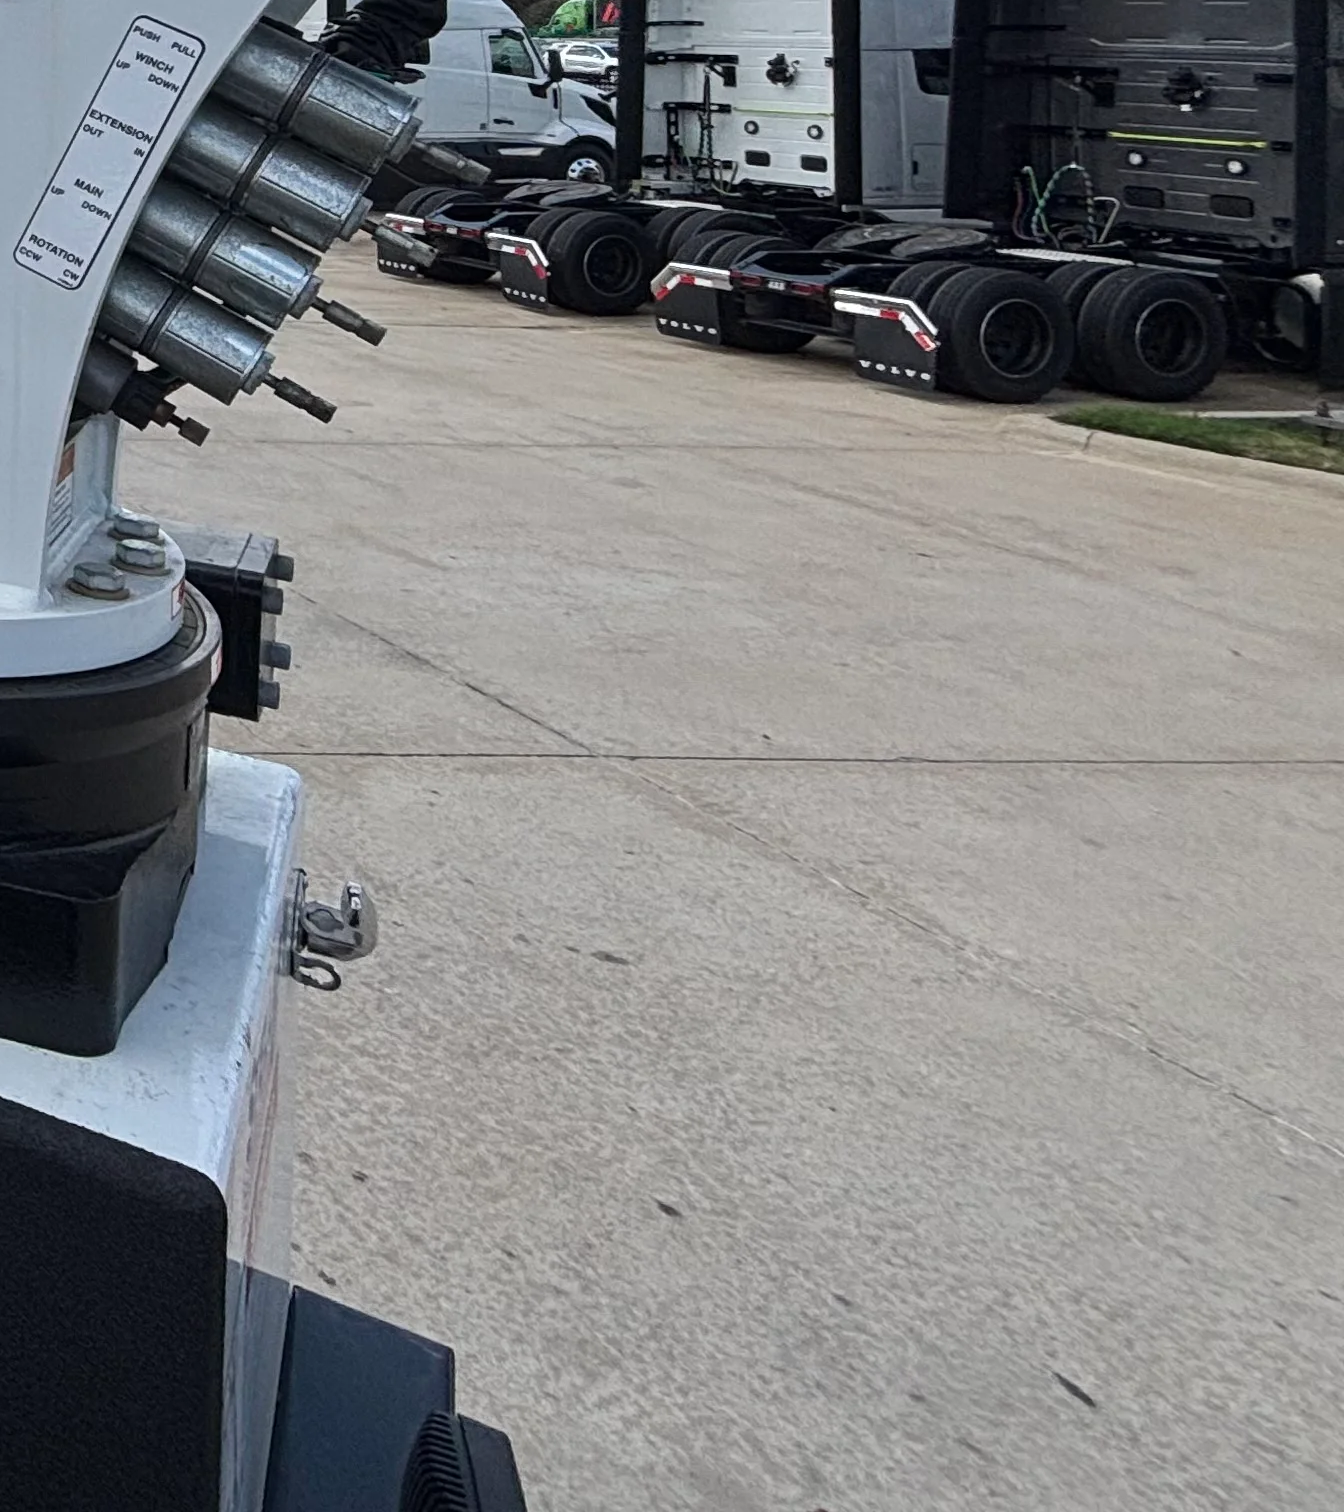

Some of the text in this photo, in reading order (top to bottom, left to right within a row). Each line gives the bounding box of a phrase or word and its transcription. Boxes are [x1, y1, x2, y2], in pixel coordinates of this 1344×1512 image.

[133, 25, 196, 59] PUSH PULL
[116, 59, 179, 93] UP DOWN
[135, 51, 174, 75] WINCH
[83, 124, 145, 158] OUT IN
[89, 109, 154, 144] EXTENSION
[50, 185, 112, 220] UP DOWN
[74, 178, 104, 199] MAIN
[19, 246, 80, 281] CCW CW
[29, 234, 84, 268] ROTATION
[658, 318, 717, 335] VOLVO
[859, 359, 932, 381] VOLVO
